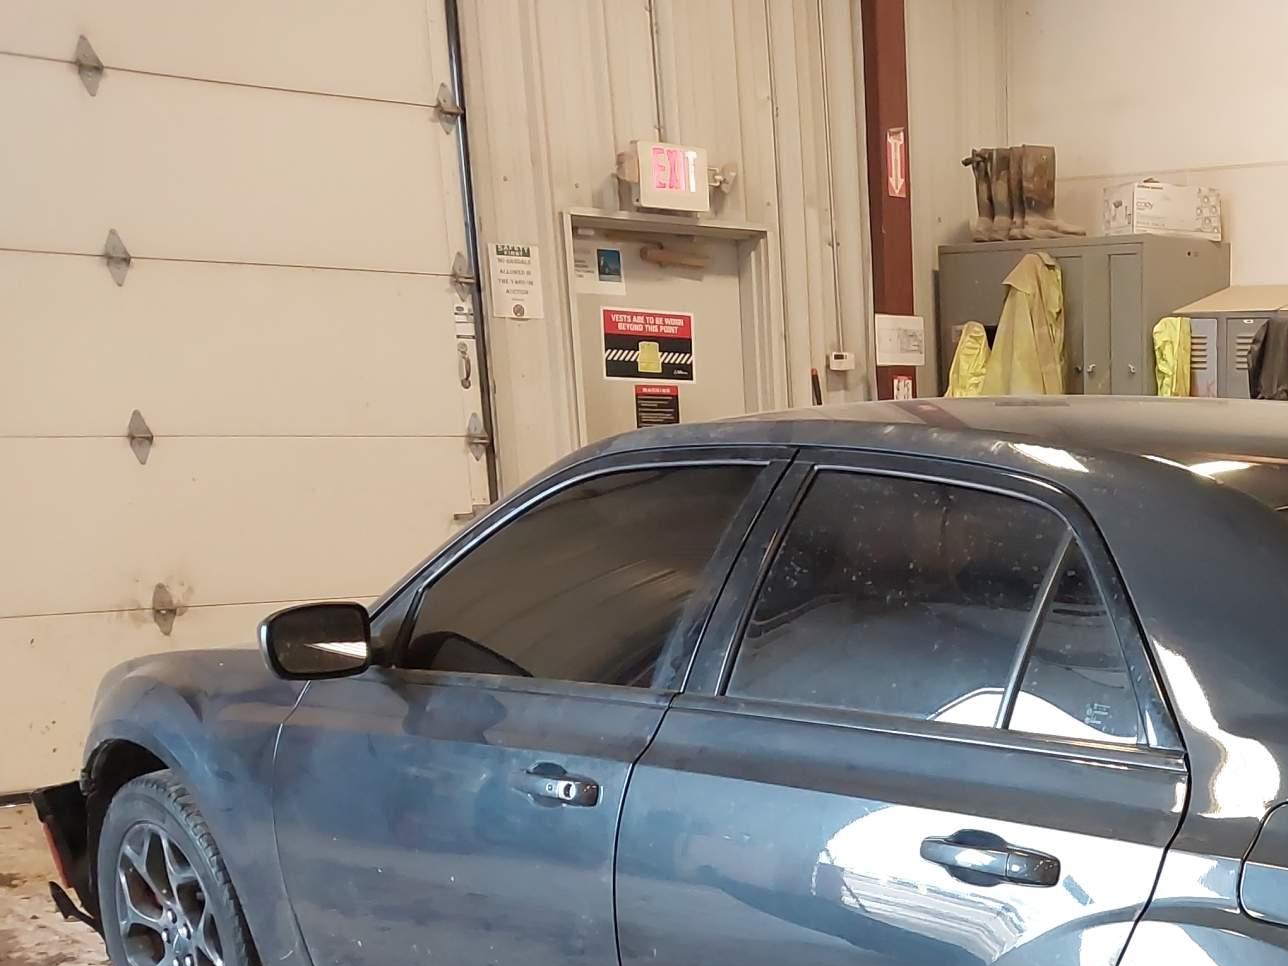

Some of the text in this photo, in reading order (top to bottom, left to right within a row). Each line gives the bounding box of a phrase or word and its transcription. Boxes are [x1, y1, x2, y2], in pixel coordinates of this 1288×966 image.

[651, 146, 697, 192] EXIT
[611, 314, 684, 327] VESTS ARE TO BE WORN
[617, 322, 679, 334] BEYOND THIS POINT
